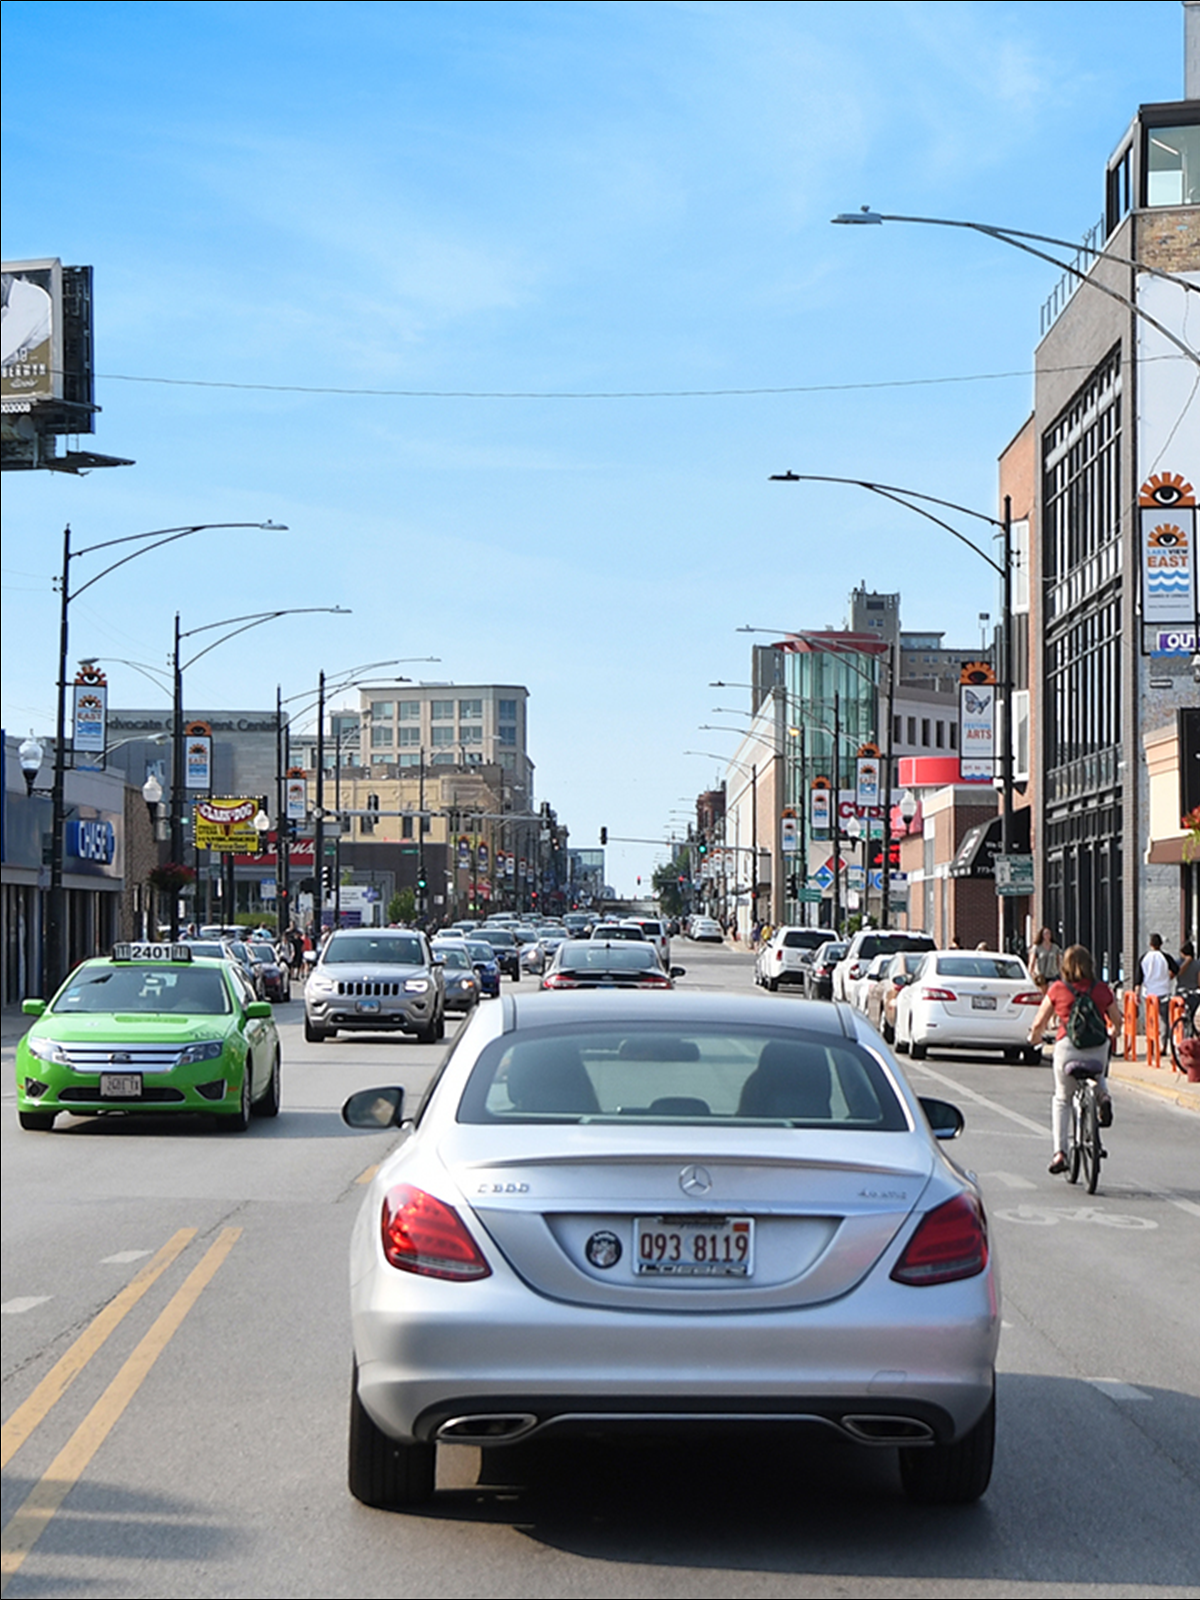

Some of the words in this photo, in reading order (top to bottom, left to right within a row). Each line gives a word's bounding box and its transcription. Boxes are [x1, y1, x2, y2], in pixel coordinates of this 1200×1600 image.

[1147, 556, 1188, 568] EAST
[108, 716, 162, 730] dvocate
[966, 729, 992, 740] ARTS
[79, 821, 106, 860] CHASE
[132, 945, 171, 960] 2401
[640, 1232, 682, 1263] Q93
[693, 1233, 749, 1263] 8119
